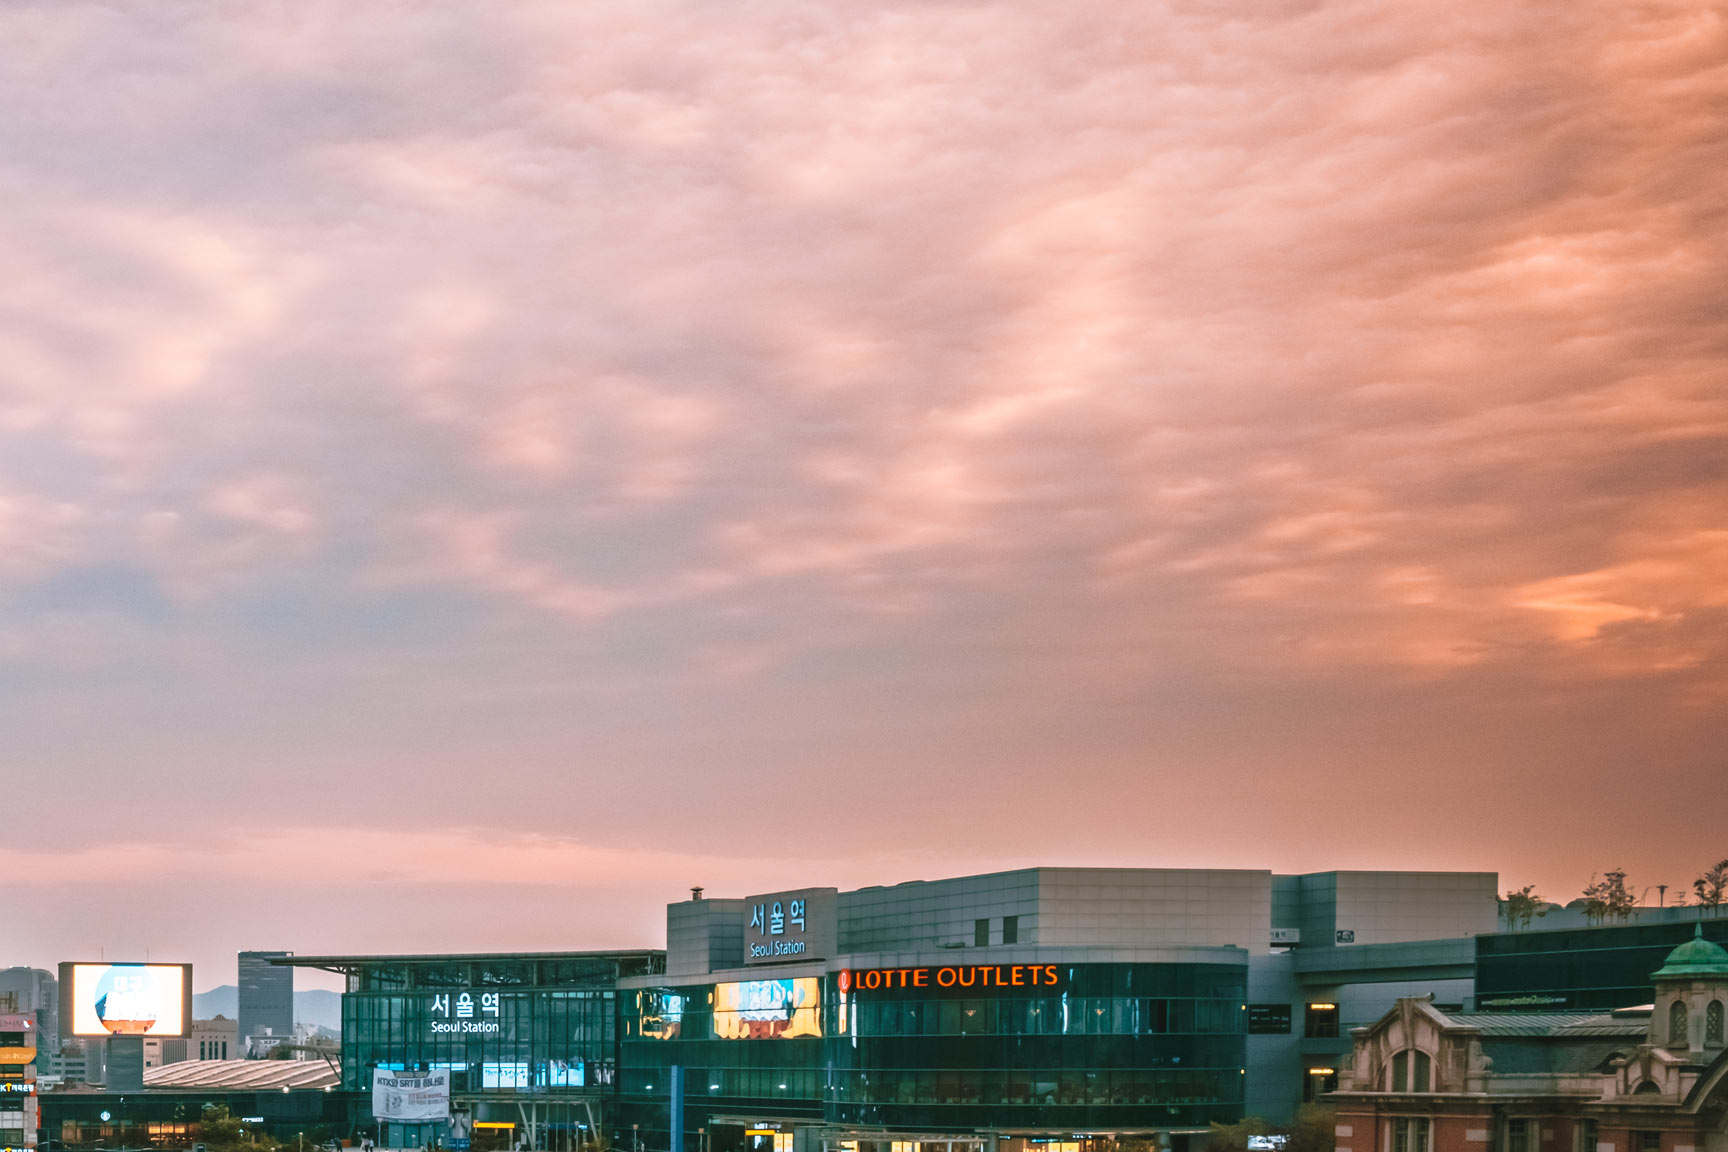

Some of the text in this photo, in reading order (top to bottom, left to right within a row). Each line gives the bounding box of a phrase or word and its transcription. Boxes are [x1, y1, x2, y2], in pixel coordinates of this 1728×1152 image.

[750, 898, 806, 936] 서울역
[750, 939, 805, 958] Seoul Station
[856, 965, 1059, 990] LOTTE OUTLETS
[431, 992, 499, 1017] 서울역
[431, 1021, 499, 1033] Seoul Station
